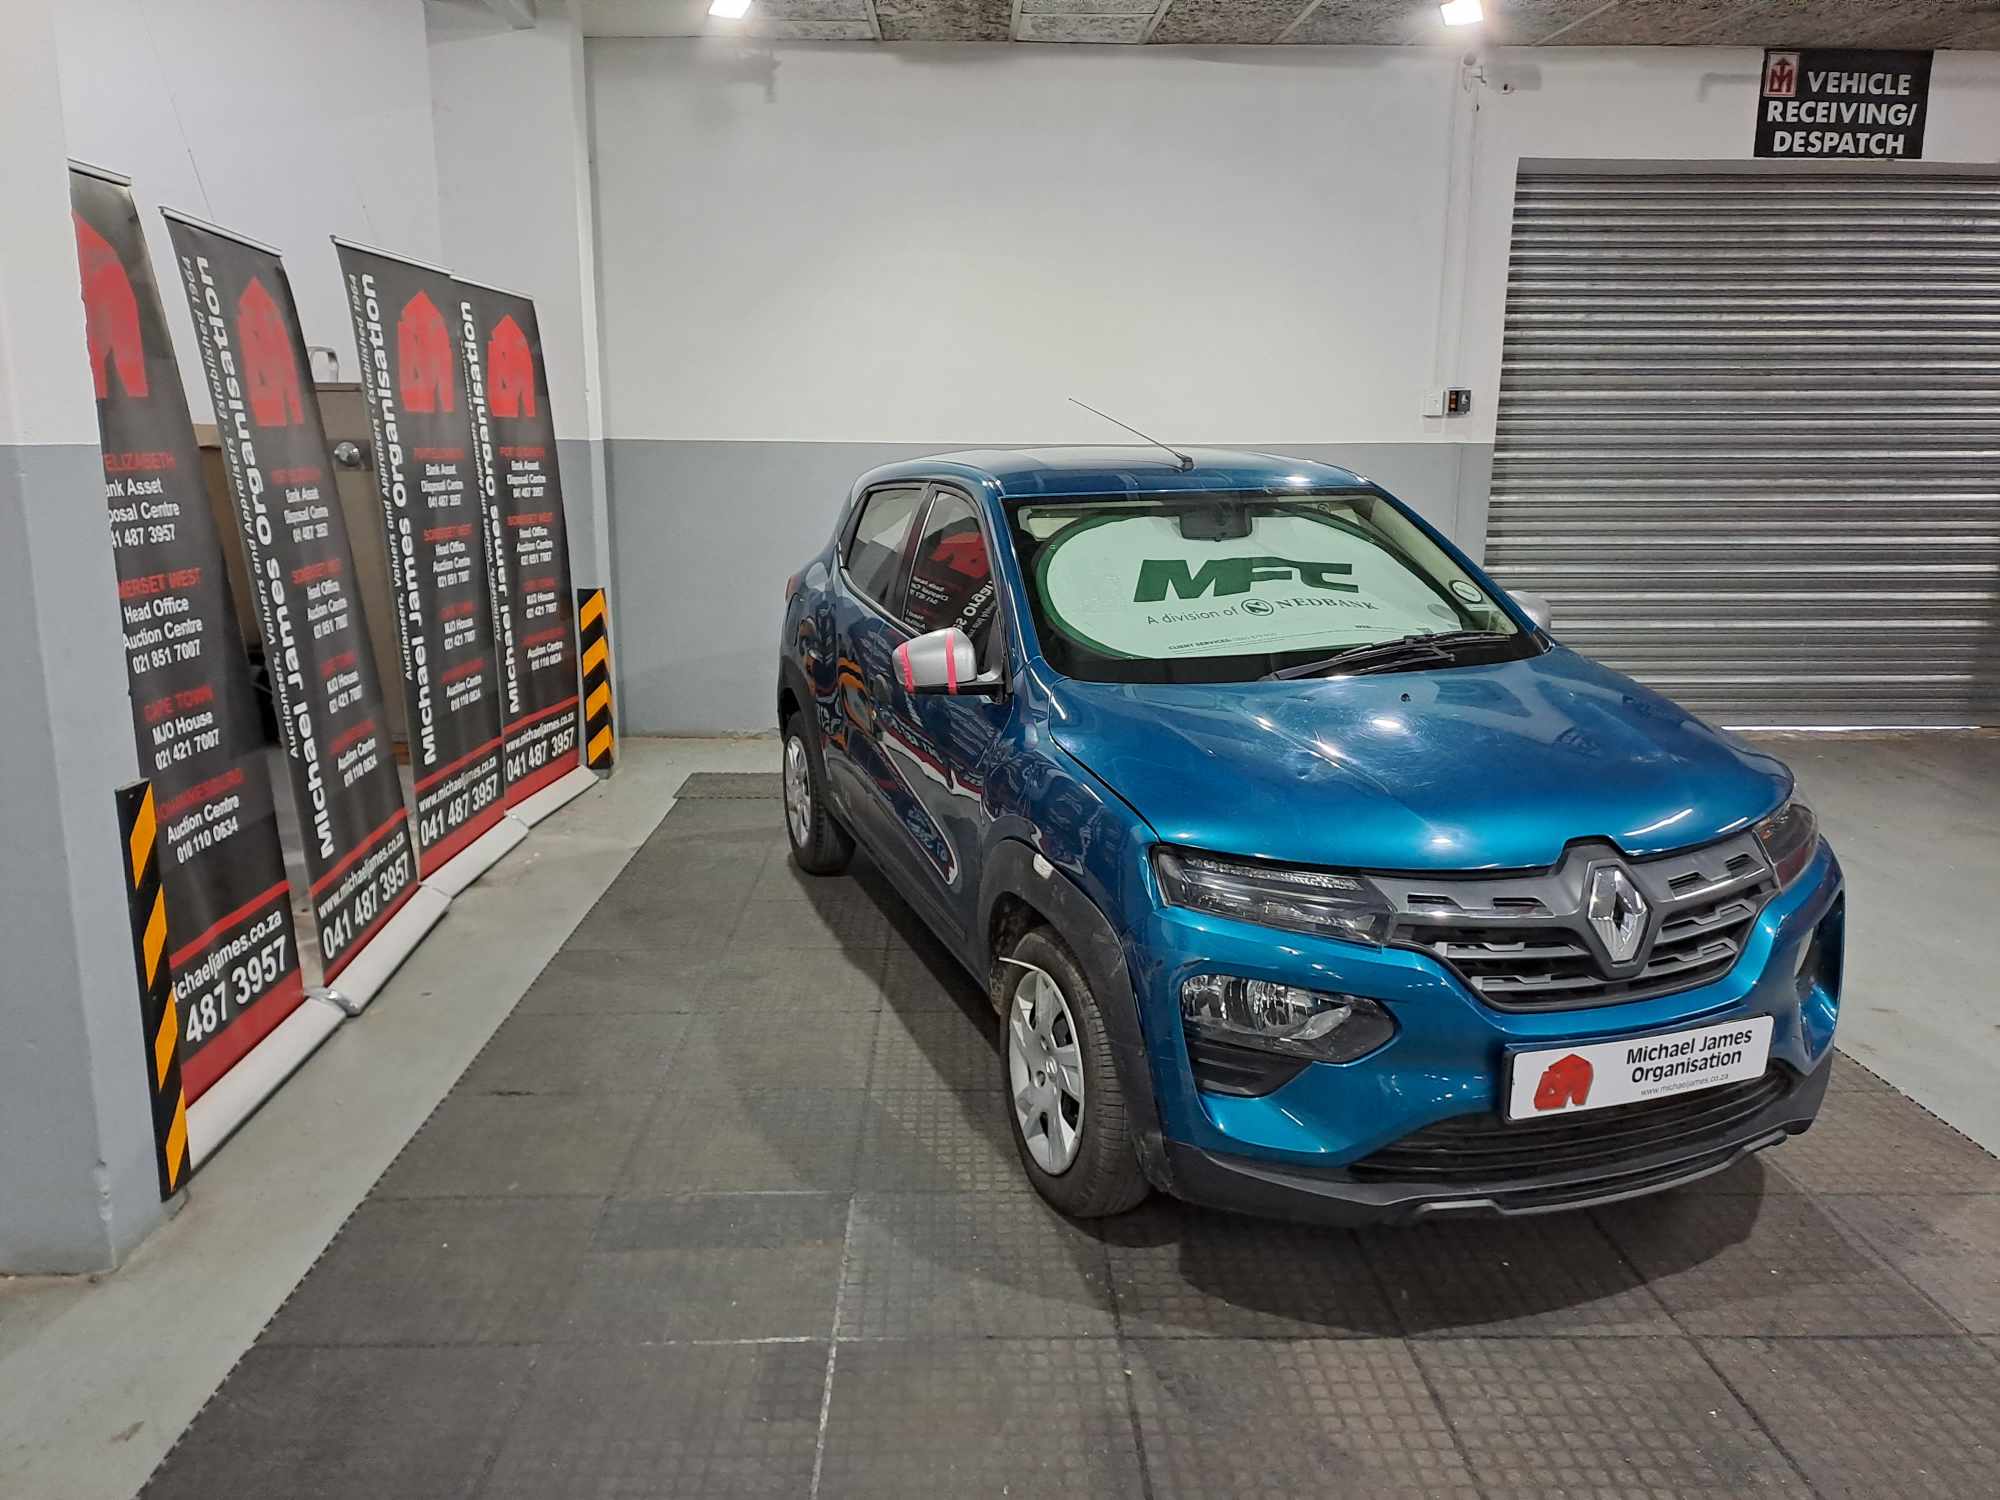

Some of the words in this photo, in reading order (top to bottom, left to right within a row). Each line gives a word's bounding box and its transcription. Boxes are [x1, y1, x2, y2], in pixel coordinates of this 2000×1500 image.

[1808, 71, 1912, 96] VEHICLE
[1767, 100, 1918, 126] RECEIVING/
[1773, 130, 1905, 155] DESPATCH
[181, 255, 201, 303] 1964
[196, 256, 272, 546] Organisation
[362, 274, 406, 507] Organisation
[461, 302, 495, 496] Organisation
[105, 477, 125, 497] ank
[127, 477, 163, 496] Asset
[225, 436, 254, 534] Appraisers
[140, 501, 180, 519] Centre
[383, 500, 395, 530] and
[124, 526, 144, 547] 487
[148, 523, 175, 543] 3957
[247, 538, 262, 574] and
[490, 505, 508, 597] James
[389, 533, 402, 588] Valuers
[399, 518, 422, 627] James
[1133, 556, 1359, 602] MFC
[123, 627, 162, 650] Auction
[164, 618, 203, 639] Centre
[124, 601, 152, 624] Head
[153, 597, 189, 616] Office
[257, 579, 276, 645] Valuers
[266, 558, 304, 690] James
[1147, 615, 1159, 625] A
[1162, 609, 1221, 624] division
[1223, 607, 1240, 618] of
[1276, 598, 1380, 611] NEDBANK
[133, 653, 150, 674] 021
[151, 646, 172, 668] 851
[173, 639, 201, 661] 7007
[398, 592, 413, 681] Auctioneers,
[500, 605, 520, 714] Michael
[273, 652, 299, 758] Auctioneers,
[411, 635, 436, 765] Michael
[152, 721, 174, 745] MJO
[175, 711, 213, 736] House
[155, 747, 172, 771] 021
[172, 739, 192, 761] 421
[194, 728, 220, 753] 7007
[506, 751, 526, 782] 041
[528, 739, 548, 768] 487
[551, 727, 575, 757] 3957
[293, 701, 335, 860] Michael
[167, 812, 203, 845] Auction
[203, 794, 240, 821] Centre
[420, 809, 444, 847] 041
[447, 792, 469, 828] 487
[472, 773, 498, 812] 3957
[176, 842, 193, 864] 010
[193, 830, 212, 851] 110
[322, 908, 352, 959] 041
[354, 881, 378, 926] 487
[379, 851, 409, 902] 3957
[172, 910, 282, 1003] ichaeljames.co.za
[185, 981, 228, 1043] 487
[232, 934, 287, 1005] 3957
[1626, 1038, 1697, 1065] Michael
[1698, 1028, 1752, 1052] James
[1631, 1050, 1742, 1083] Organisation
[1640, 1072, 1729, 1096] www.michaeljames.co.za
